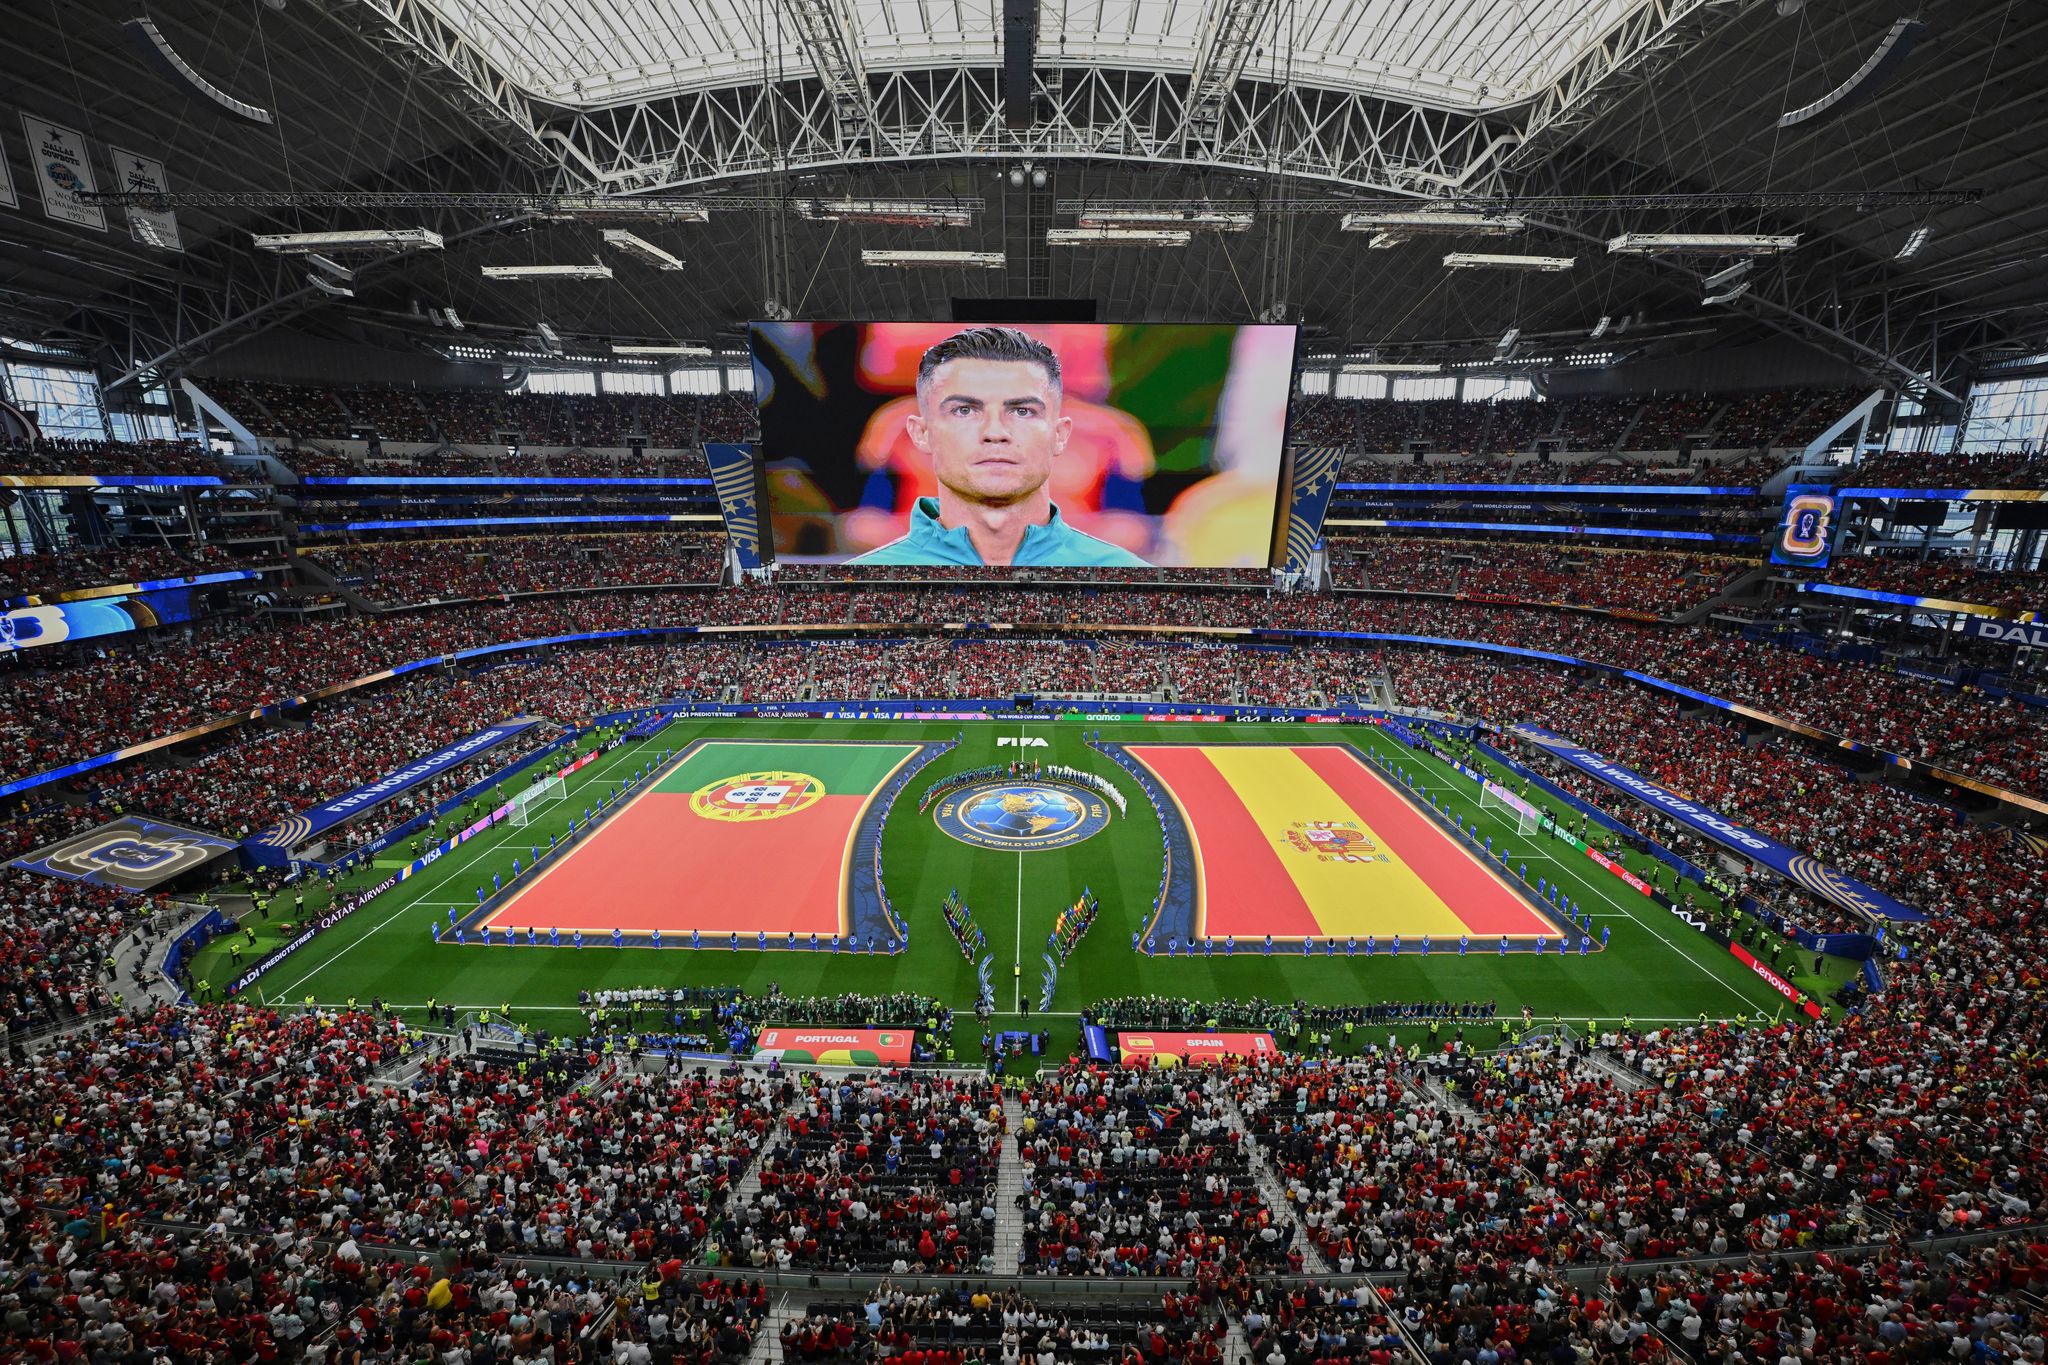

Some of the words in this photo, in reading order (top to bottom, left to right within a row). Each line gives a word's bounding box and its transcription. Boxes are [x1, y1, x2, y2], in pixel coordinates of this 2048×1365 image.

[41, 148, 80, 166] COWBOYS
[42, 141, 74, 157] DALLAS
[128, 171, 156, 185] DALLAS
[47, 197, 100, 217] CHAMPIONS
[67, 210, 86, 222] 1993
[996, 737, 1049, 747] FIFA
[325, 788, 374, 813] FIFA
[375, 763, 429, 794] WORLD
[429, 750, 458, 767] CUP
[453, 729, 503, 753] 2026
[1464, 766, 1478, 782] VISA
[1572, 753, 1605, 769] FIFA
[1603, 767, 1662, 799] WORLD
[1660, 793, 1700, 815] CUP
[1694, 812, 1769, 850] 2026
[941, 803, 955, 818] FIFA
[1090, 803, 1103, 818] FIFA
[371, 837, 387, 851] FIFA
[963, 832, 984, 843] FIFA
[984, 838, 1022, 847] WORLD
[1023, 839, 1045, 847] CUP
[1046, 832, 1080, 846] 2026
[421, 847, 442, 867] VISA
[320, 901, 356, 930] QATAR
[358, 876, 396, 906] AIRWAYS
[238, 969, 261, 990] ADI
[260, 928, 316, 974] PREDICTSTREET
[1752, 959, 1792, 997] Lenovo
[794, 1035, 860, 1044] PORTUGAL
[1186, 1039, 1225, 1047] SPAIN
